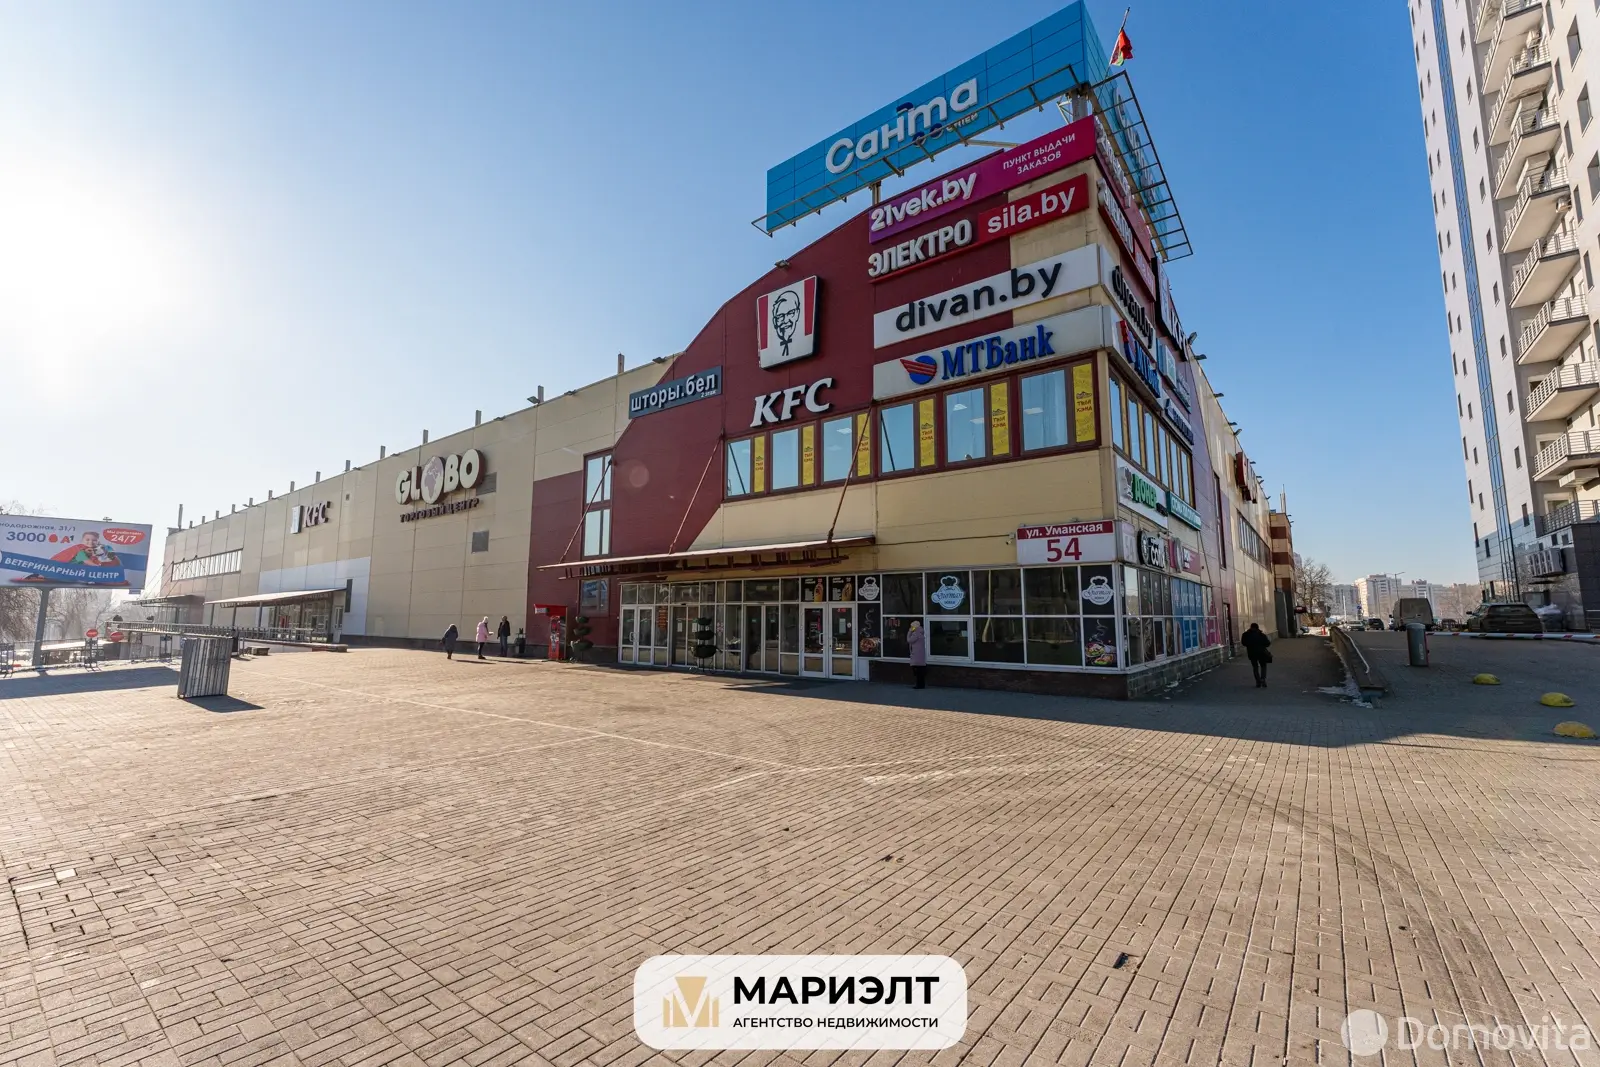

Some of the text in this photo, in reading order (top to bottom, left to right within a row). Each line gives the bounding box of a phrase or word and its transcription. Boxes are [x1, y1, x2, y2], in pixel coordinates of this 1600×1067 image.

[825, 77, 978, 174] Санта
[1002, 132, 1076, 170] ПУНКТ ВЫДАЧИ
[1017, 150, 1062, 175] ЗАКАЗОВ
[871, 172, 977, 232] 21vek.by
[987, 186, 1076, 234] sila.by
[867, 218, 973, 278] ЭЛЕКТРО
[895, 262, 1062, 332] divan.by
[940, 323, 1056, 381] МТБанк
[631, 373, 716, 412] шторы.бел
[750, 377, 833, 428] KFC
[395, 448, 484, 505] GLOBO
[301, 500, 331, 528] KFC
[400, 498, 480, 523] ТОРГОВЫЙ ЦЕНТР
[6, 531, 46, 543] 3000
[110, 534, 137, 544] 24/7
[1026, 523, 1103, 539] ул. Уманская
[1046, 537, 1082, 563] 54
[4, 557, 120, 580] ВЕТЕРИНАРНЫЙ ЦЕНТР
